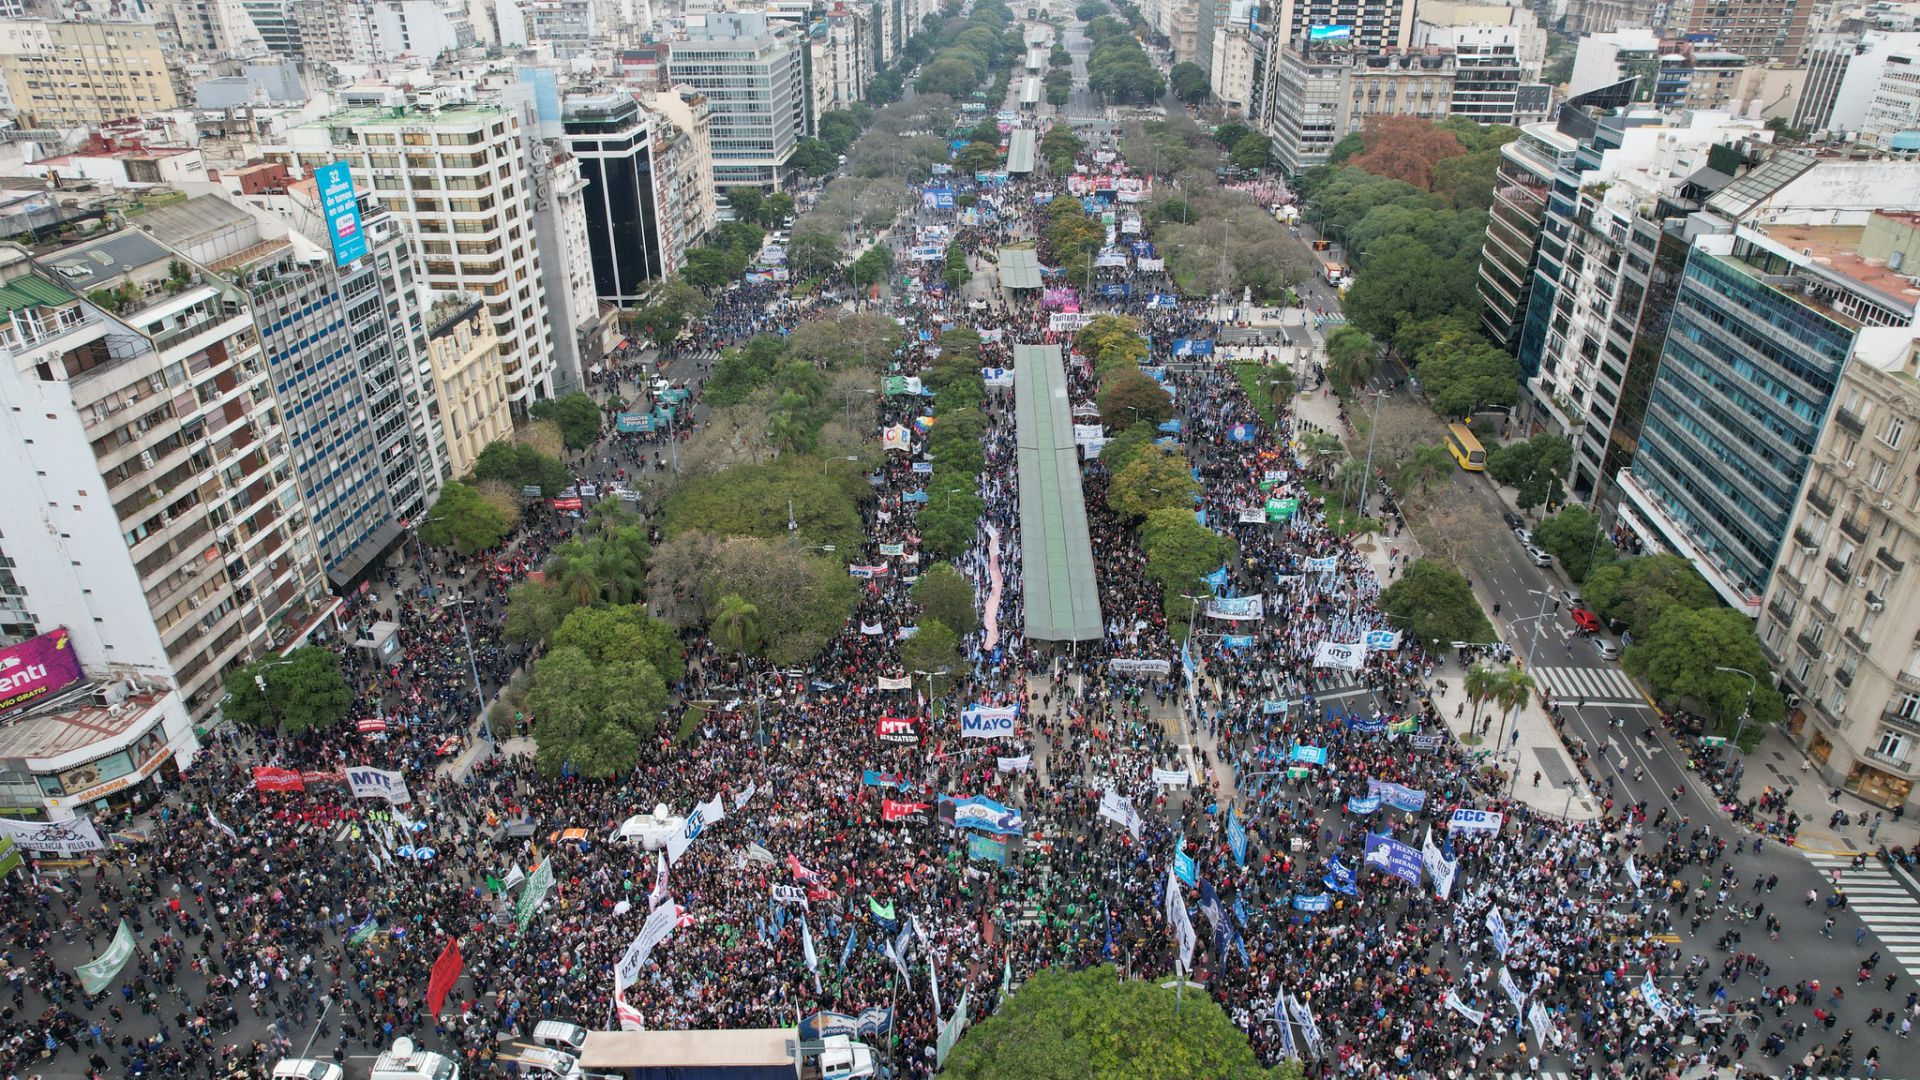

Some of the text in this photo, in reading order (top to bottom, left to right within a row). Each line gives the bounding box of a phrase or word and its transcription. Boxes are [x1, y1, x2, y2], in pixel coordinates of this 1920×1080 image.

[329, 170, 341, 183] 32
[1269, 500, 1288, 509] FNC
[1328, 648, 1352, 659] UTEP
[16, 686, 47, 702] GRATIS
[881, 721, 915, 734] MTL
[963, 713, 1013, 731] MAYO
[351, 772, 392, 791] MTE
[78, 777, 129, 801] HAVANNA
[891, 802, 924, 813] MTL
[1454, 810, 1487, 823] CCC
[66, 840, 97, 850] VILLERA
[1392, 842, 1422, 860] FRENTE
[1402, 853, 1413, 862] DE
